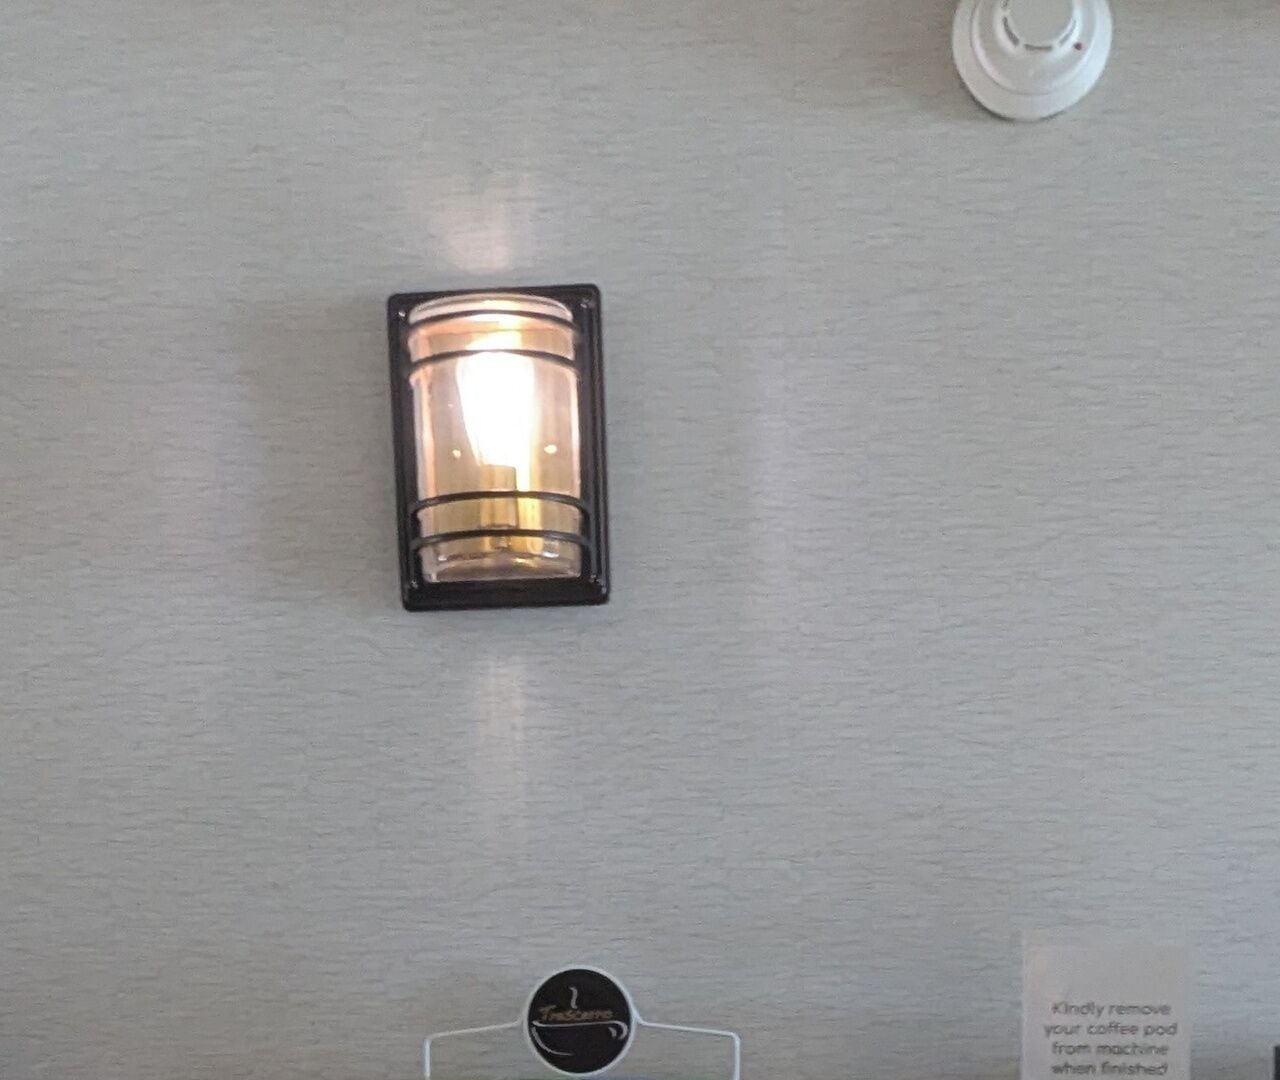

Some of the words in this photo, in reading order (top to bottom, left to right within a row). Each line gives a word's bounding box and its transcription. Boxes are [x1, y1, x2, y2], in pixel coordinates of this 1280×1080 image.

[1052, 1001, 1105, 1017] Kindly
[1108, 1003, 1172, 1016] remove
[1044, 1023, 1081, 1038] your
[1086, 1021, 1139, 1036] coffee
[1143, 1022, 1178, 1037] pod
[1052, 1041, 1091, 1056] from
[1095, 1042, 1169, 1056] machine
[1051, 1062, 1096, 1075] when
[1100, 1061, 1169, 1076] finished
